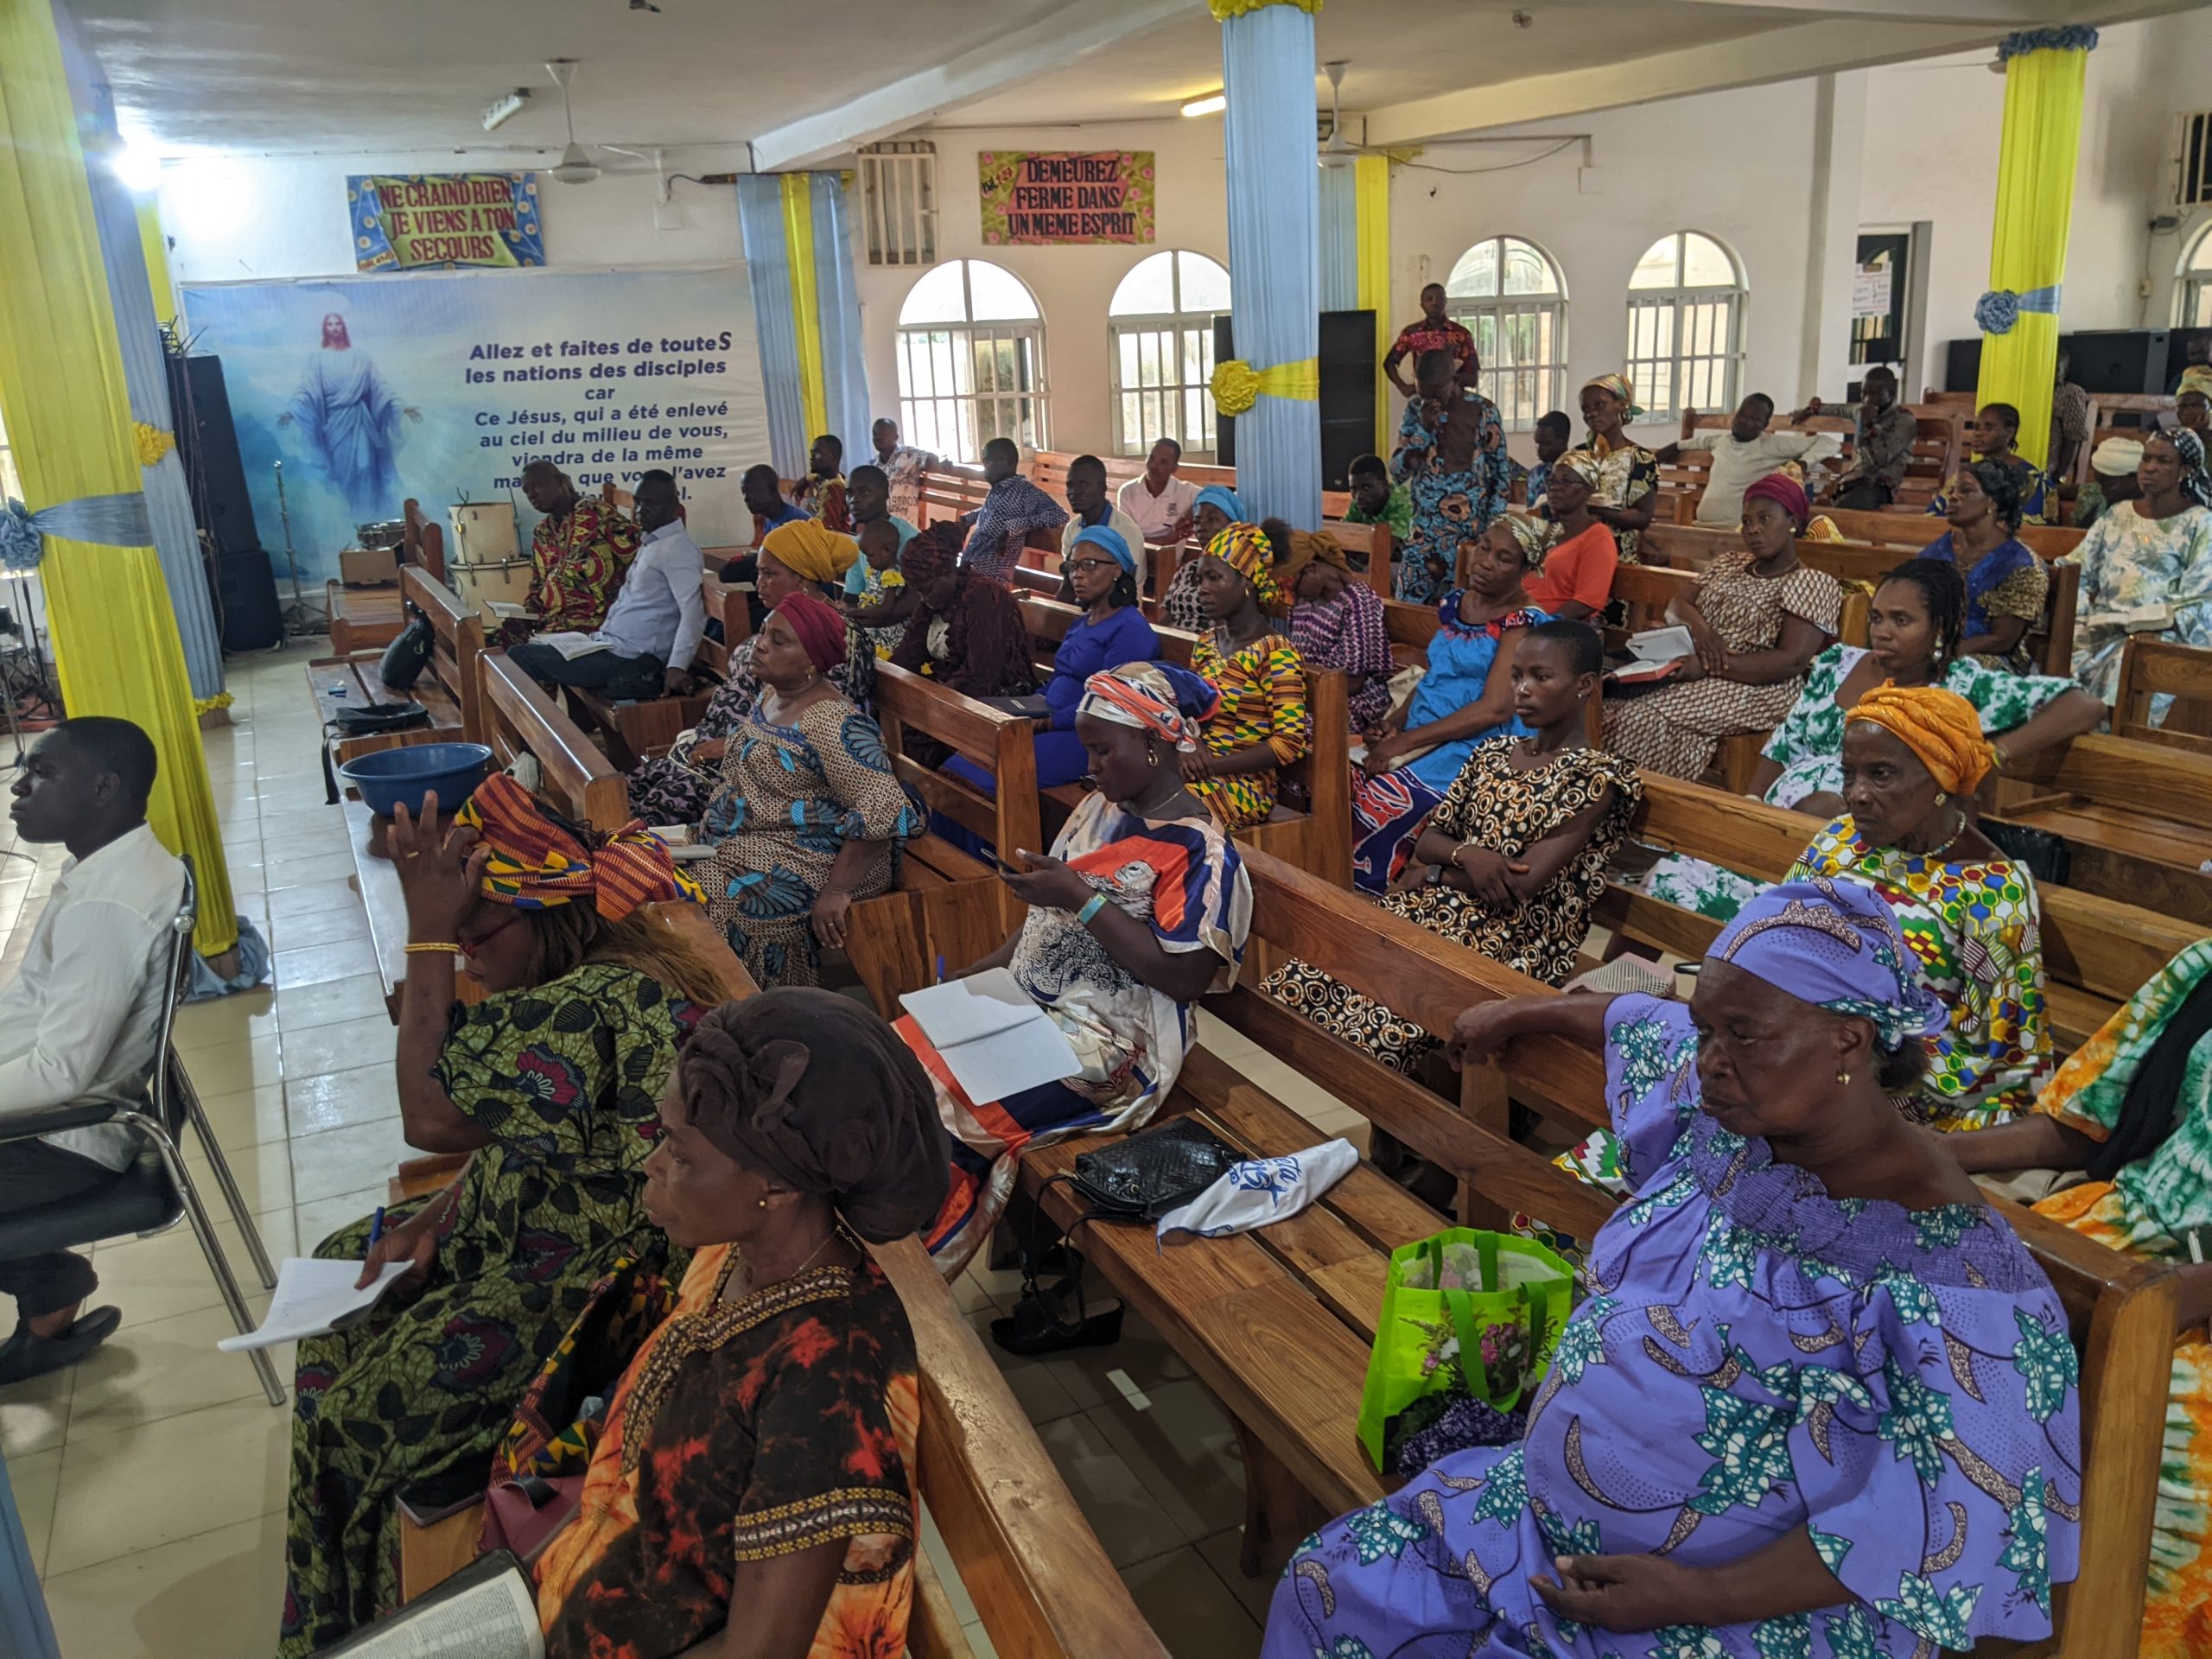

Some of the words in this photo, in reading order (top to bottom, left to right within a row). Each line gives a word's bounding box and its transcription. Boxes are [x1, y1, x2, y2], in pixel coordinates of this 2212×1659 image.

[1027, 159, 1120, 183] DEMEUREZ
[378, 184, 404, 208] NE
[405, 181, 471, 207] CRAIND
[471, 179, 512, 204] RIEN
[1015, 187, 1073, 210] FERME
[1077, 187, 1121, 209] DANS
[390, 212, 410, 241] JE
[412, 210, 467, 234] VIENS
[471, 208, 484, 232] A
[483, 207, 516, 232] TON
[1007, 213, 1030, 236] UN
[1033, 213, 1079, 236] MEME
[1081, 213, 1136, 236] ESPRIT
[410, 235, 495, 261] SECOURS
[469, 343, 524, 360] Allez
[531, 342, 553, 358] et
[560, 340, 620, 357] faites
[626, 338, 653, 354] de
[465, 367, 496, 384] les
[503, 365, 582, 382] nations
[589, 362, 626, 378] des
[633, 359, 727, 378] disciples
[584, 388, 615, 400] car
[474, 412, 500, 426] Ce
[506, 410, 567, 425] Jésus,
[574, 406, 604, 424] qui
[610, 409, 621, 421] a
[628, 404, 659, 420] été
[665, 401, 728, 418] enlevé
[480, 435, 503, 448] au
[510, 430, 544, 446] ciel
[551, 429, 575, 444] du
[582, 427, 641, 442] milieu
[648, 425, 672, 440] de
[678, 425, 728, 439] vous,
[591, 449, 615, 463] de
[622, 448, 638, 462] la
[645, 445, 703, 461] même
[578, 472, 614, 486] que
[672, 466, 726, 480] l'avez
